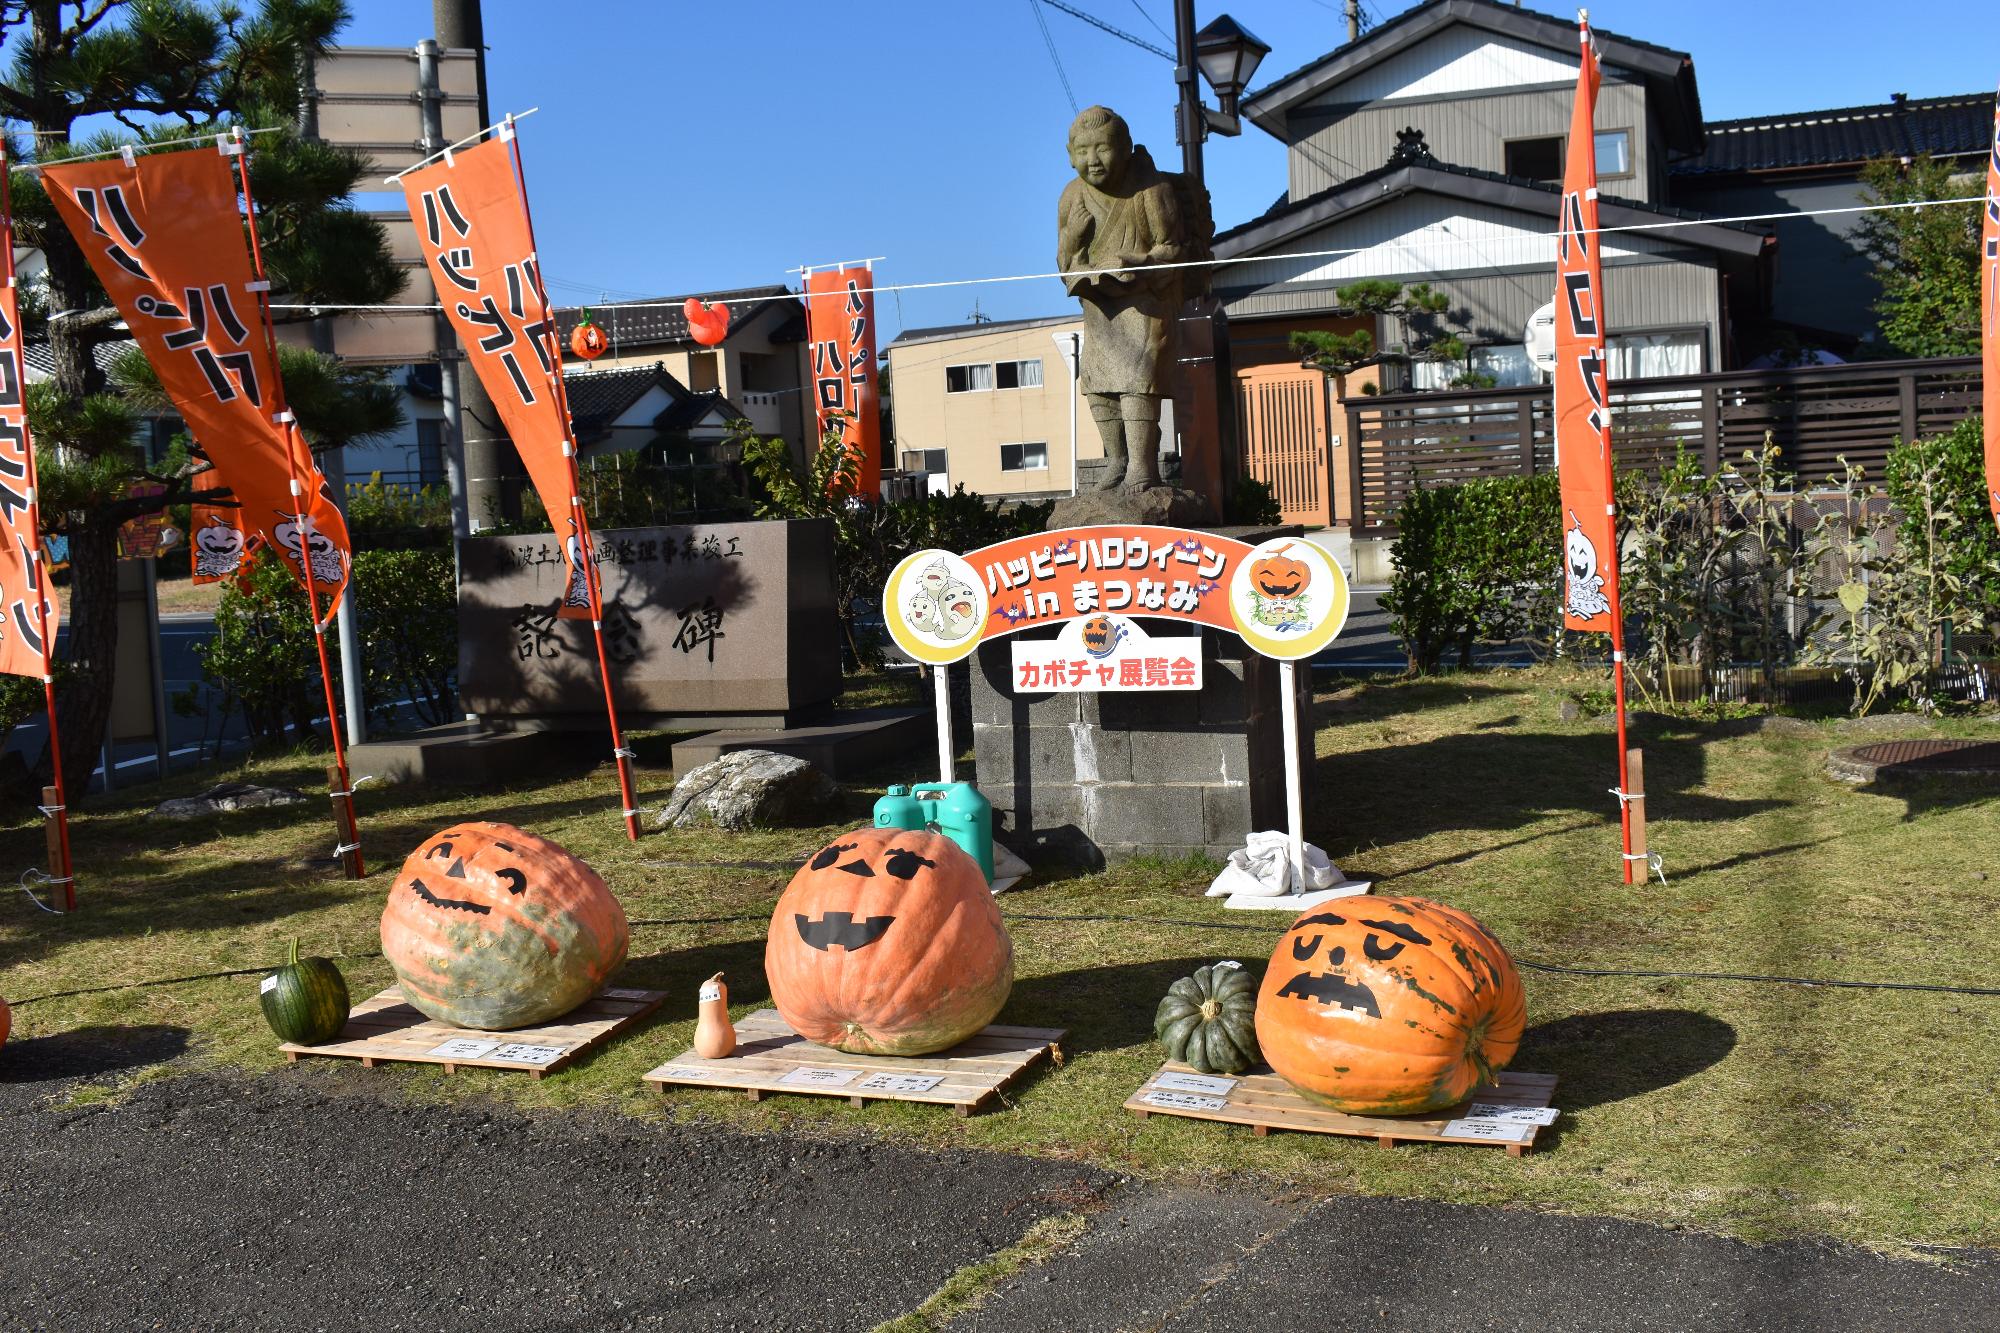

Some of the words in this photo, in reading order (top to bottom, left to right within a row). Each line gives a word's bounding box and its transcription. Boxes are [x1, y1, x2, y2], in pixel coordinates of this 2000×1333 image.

[498, 534, 744, 570] 松波土画整理事業竣工
[985, 536, 1226, 597] ハッピーハロウィーン
[1023, 588, 1061, 618] in
[1072, 577, 1200, 613] まつなみ
[512, 596, 726, 663] 記念碑
[1018, 656, 1196, 688] カボチャ展覧会
